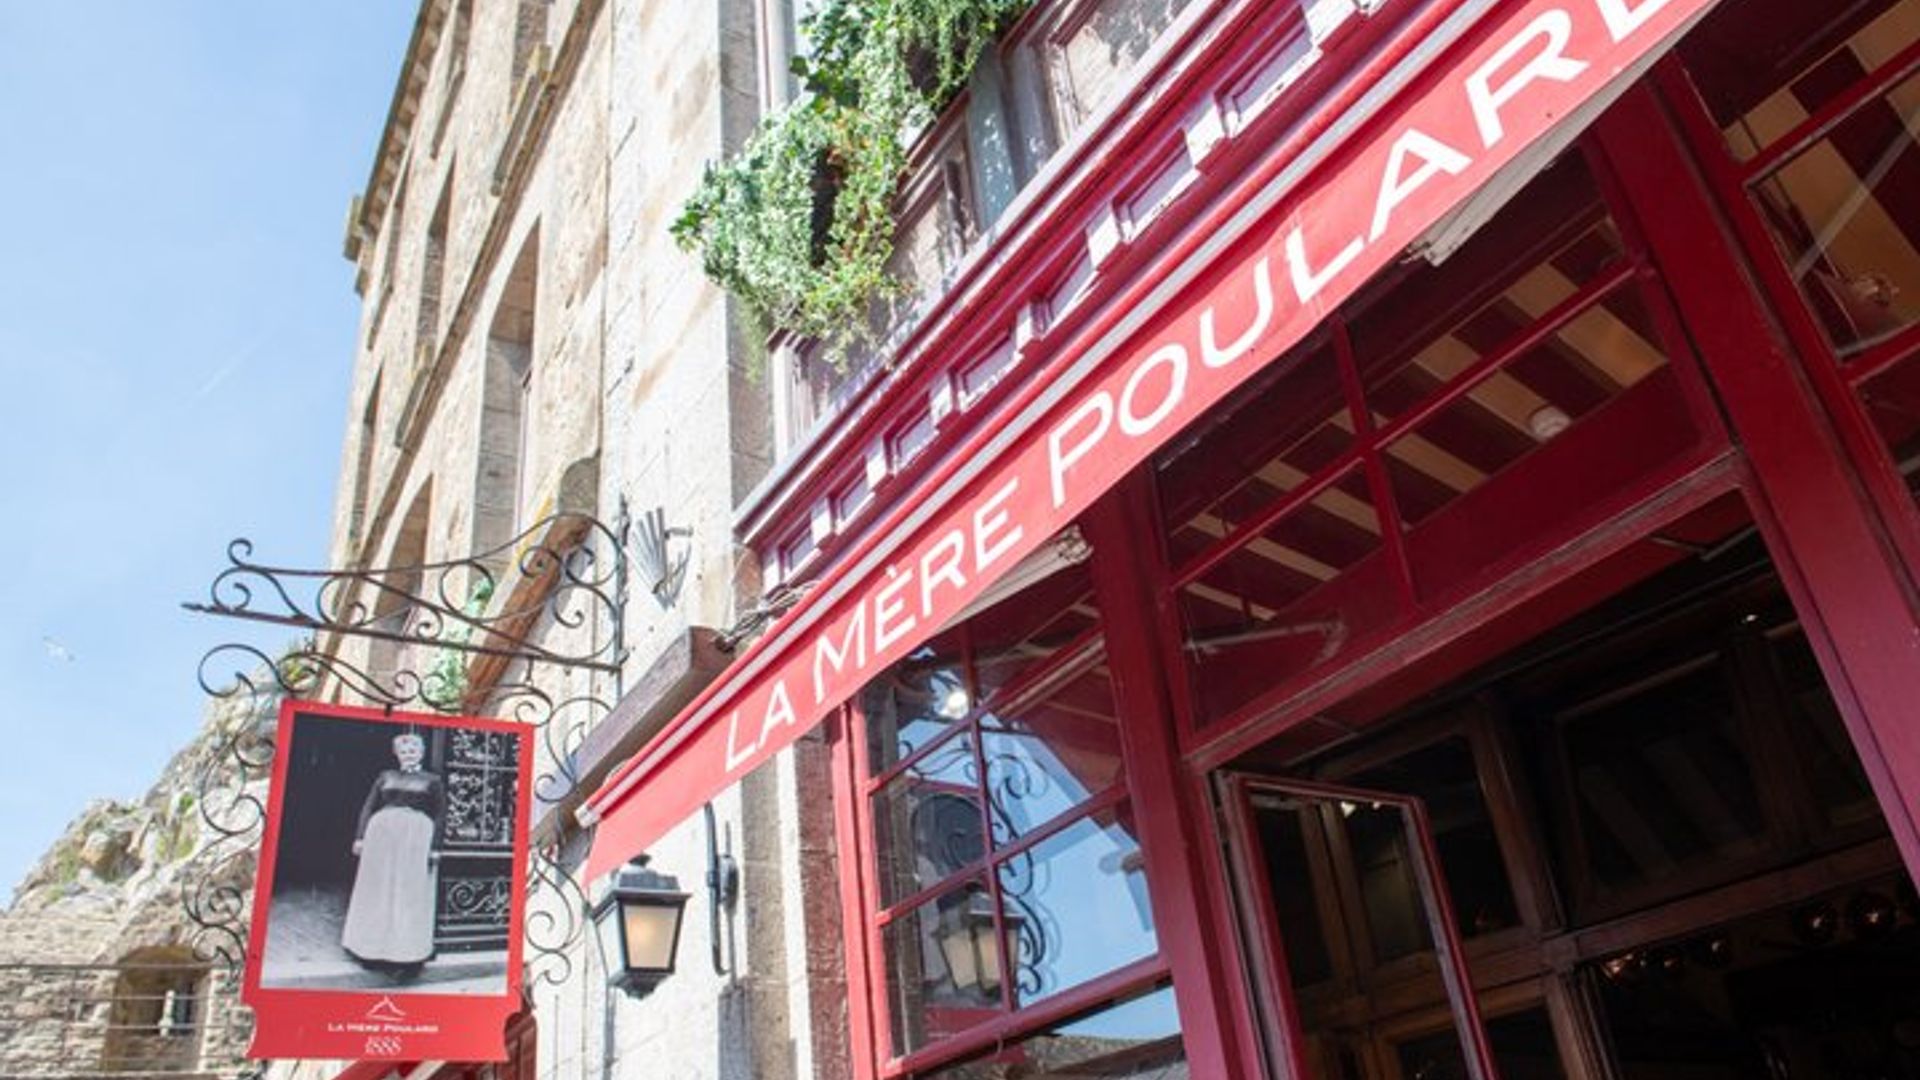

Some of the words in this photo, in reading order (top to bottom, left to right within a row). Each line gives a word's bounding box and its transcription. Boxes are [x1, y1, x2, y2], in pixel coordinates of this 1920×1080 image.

[725, 679, 796, 773] LA
[812, 476, 1024, 704] MÈRE
[327, 1022, 345, 1033] LA
